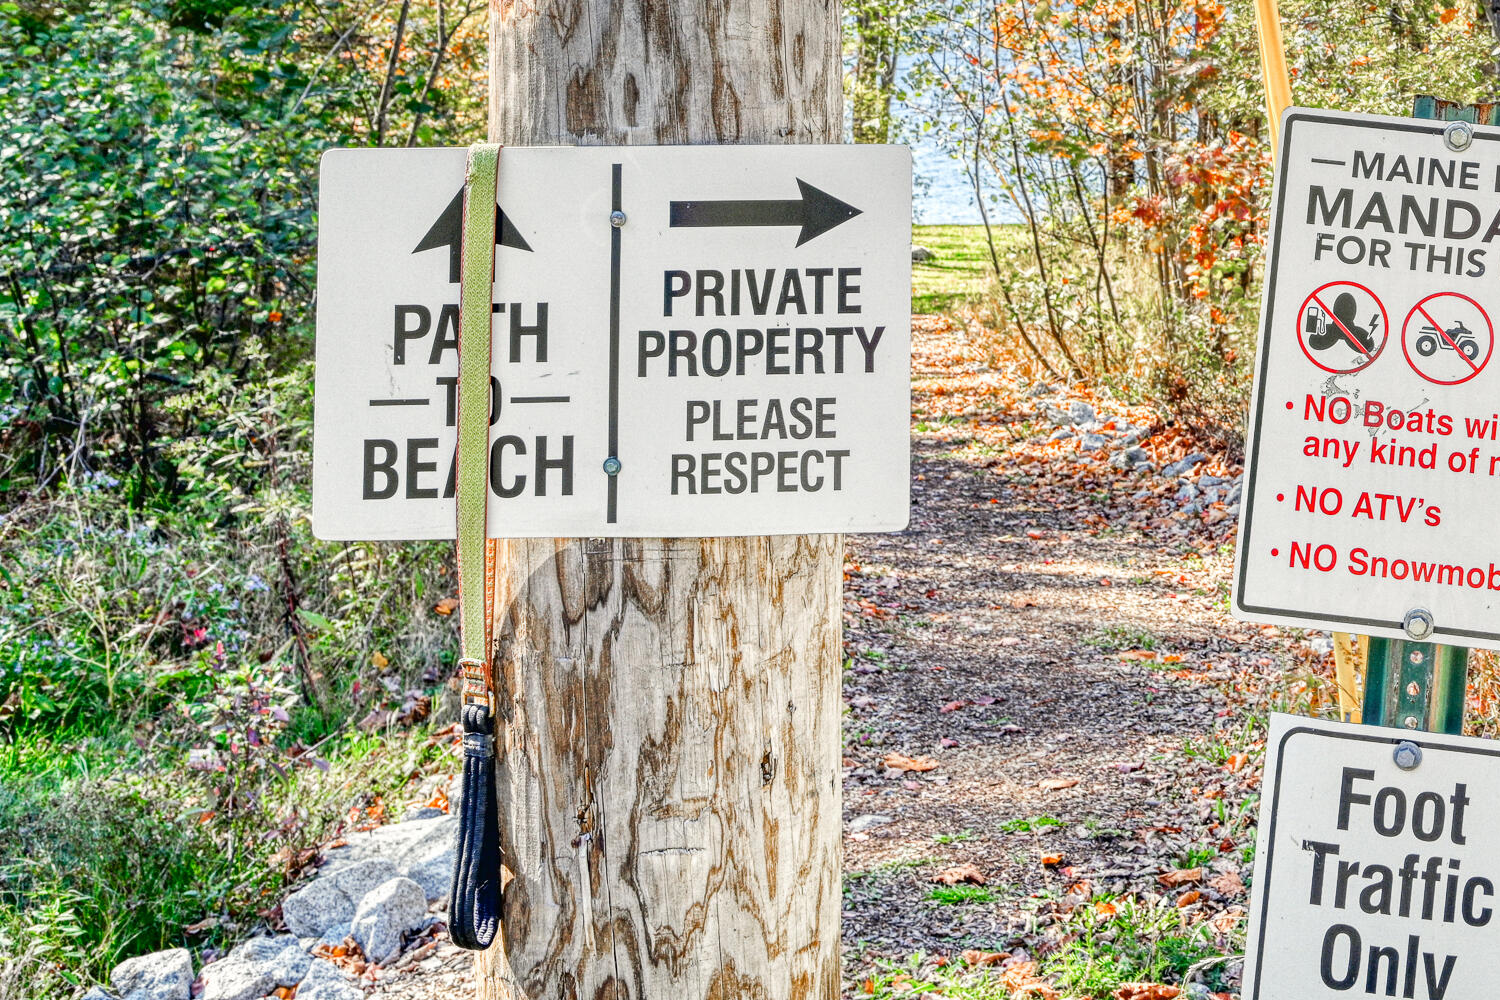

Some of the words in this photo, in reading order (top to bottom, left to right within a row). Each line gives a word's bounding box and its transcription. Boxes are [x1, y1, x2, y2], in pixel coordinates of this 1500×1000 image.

[1351, 150, 1481, 191] MAINE
[1314, 233, 1391, 269] FOR
[1404, 242, 1486, 278] THIS
[663, 267, 862, 317] PRIVATE
[637, 325, 885, 378] PROPERTY
[685, 397, 837, 442] PLEASE
[1303, 394, 1352, 425] NO
[1363, 400, 1454, 437] Boats
[670, 448, 850, 496] RESPECT
[1303, 436, 1360, 468] any
[1370, 437, 1437, 470] kind
[1448, 446, 1481, 474] of
[1294, 485, 1343, 516] NO
[1352, 491, 1442, 527] ATV’s
[1288, 541, 1338, 572] NO
[1336, 767, 1470, 846] Foot
[1301, 839, 1495, 927] Traffic
[1319, 923, 1458, 1000] Only
